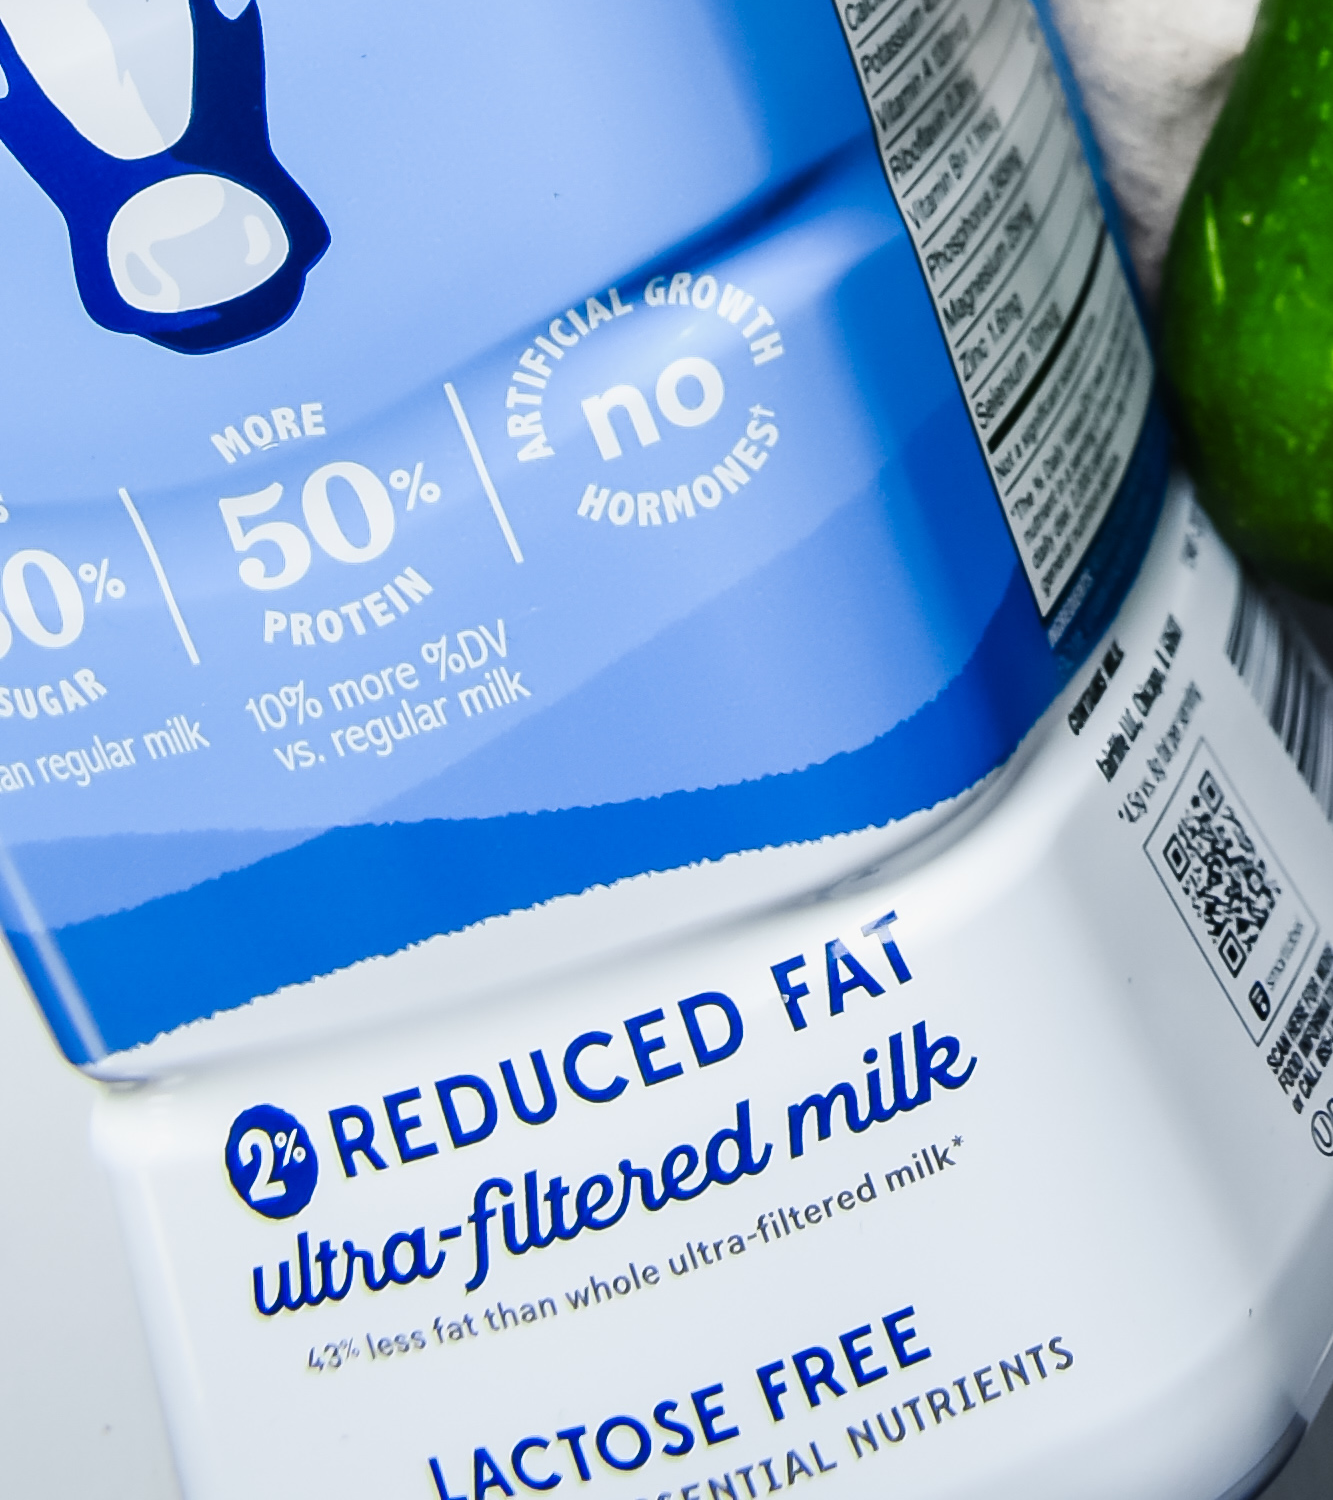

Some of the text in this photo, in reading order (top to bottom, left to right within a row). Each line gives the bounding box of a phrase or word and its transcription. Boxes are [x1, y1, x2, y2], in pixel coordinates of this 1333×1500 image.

[504, 271, 786, 467] ARTIFICIAL GROWTH
[579, 355, 726, 462] no
[210, 401, 328, 465] MORE
[262, 565, 434, 647] PROTEIN
[244, 618, 513, 735] 10% more %DV
[335, 665, 534, 760] regular milk
[36, 713, 211, 788] regular milk
[327, 908, 916, 1181] REDUCED FAT
[250, 1019, 978, 1319] ultra-filtered milk
[363, 1174, 880, 1364] less fat than whole ultra-filtered
[426, 1303, 933, 1500] LACTOSE FREE
[845, 1333, 1076, 1459] NUTRIENTS
